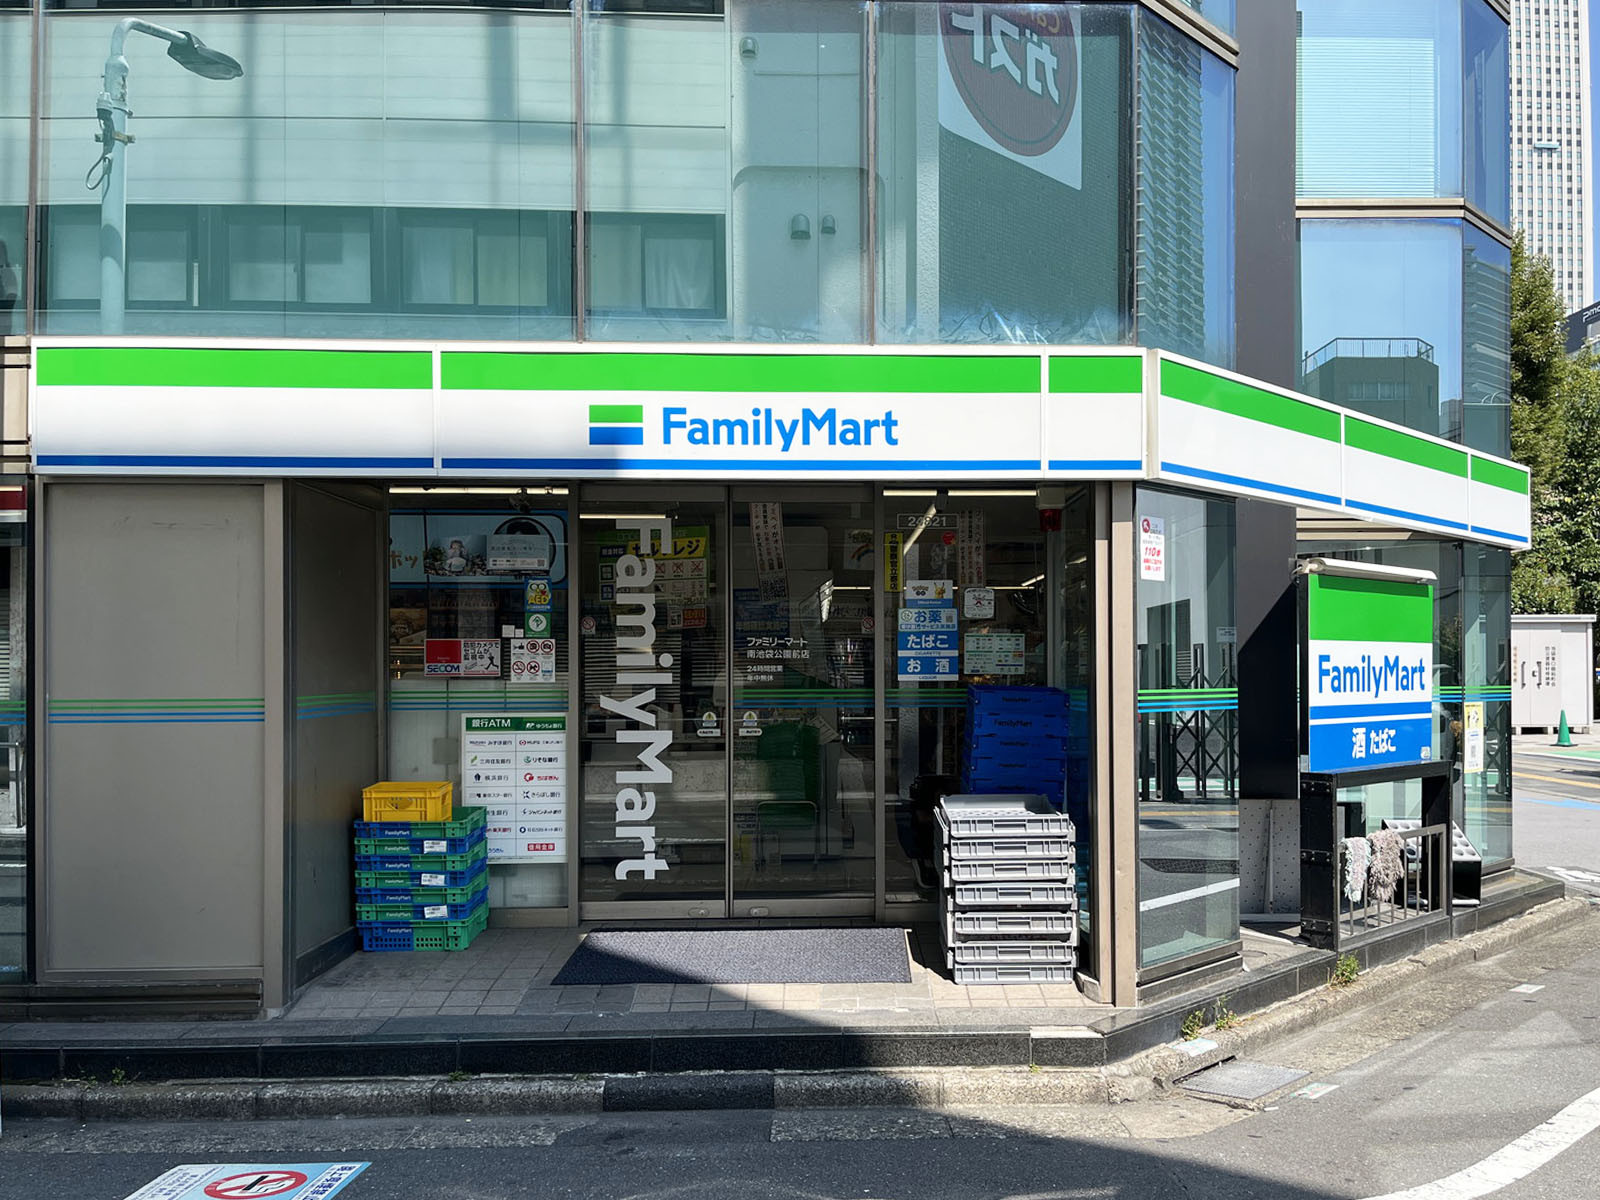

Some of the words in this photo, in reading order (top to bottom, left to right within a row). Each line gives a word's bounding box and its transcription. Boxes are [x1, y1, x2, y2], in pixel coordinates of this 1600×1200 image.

[663, 408, 898, 452] FamilyMart
[528, 594, 550, 605] AED
[914, 610, 942, 624] お薬
[746, 637, 809, 648] ファミリーマート
[907, 634, 949, 649] たばこ
[746, 650, 810, 659] 南池袋公園前店
[427, 664, 460, 673] SECOM
[907, 658, 950, 673] お酒
[1318, 654, 1425, 698] FamilyMart
[599, 518, 673, 880] FamilyMart
[472, 719, 511, 728] 銀行ATM
[994, 719, 1033, 728] FamilyMart
[1352, 727, 1367, 759] 酒
[1369, 727, 1397, 754] たばこ
